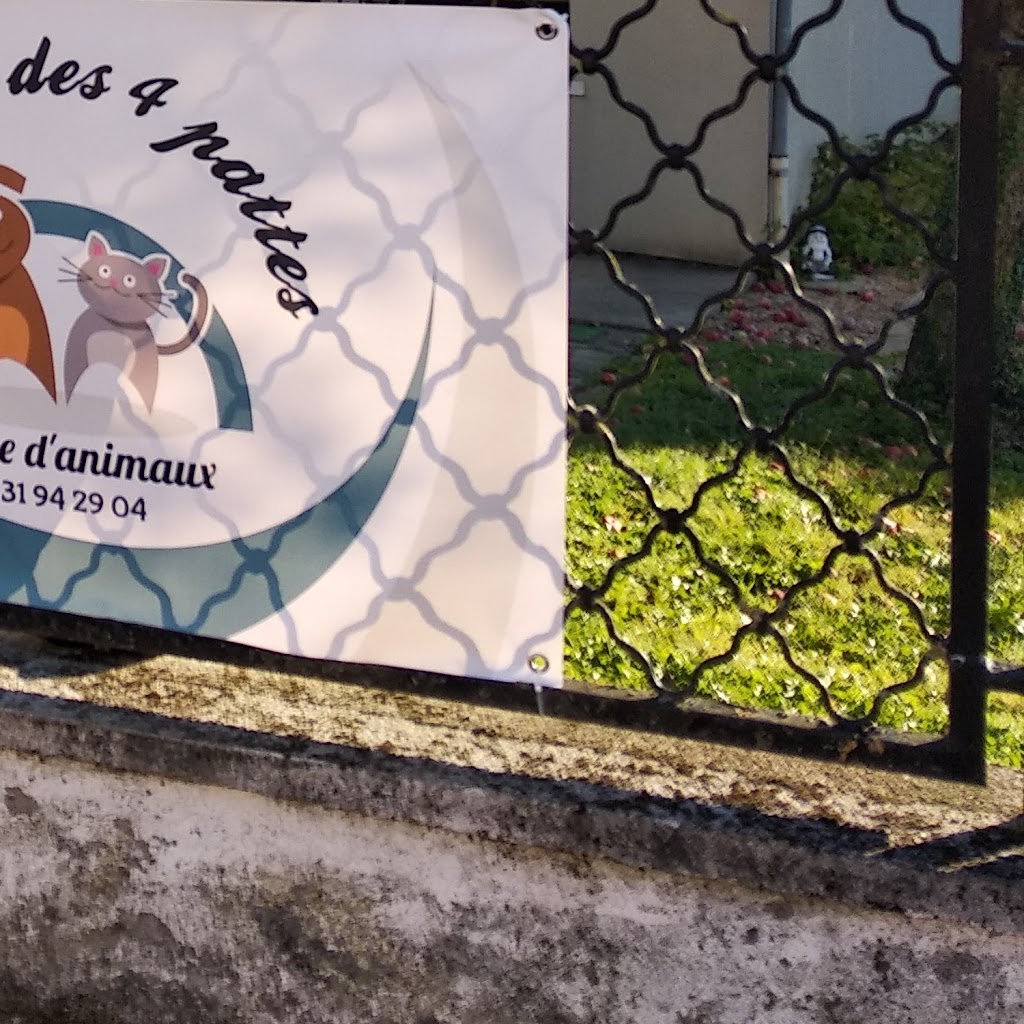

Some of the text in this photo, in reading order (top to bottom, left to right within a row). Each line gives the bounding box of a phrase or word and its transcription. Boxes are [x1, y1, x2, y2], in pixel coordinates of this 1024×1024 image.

[6, 36, 113, 100] des
[128, 77, 179, 117] 4
[149, 121, 319, 319] pattes
[24, 433, 216, 490] d'animaux
[1, 480, 26, 505] 31
[33, 485, 65, 510] 94
[72, 490, 104, 515] 29
[111, 496, 147, 521] 04
